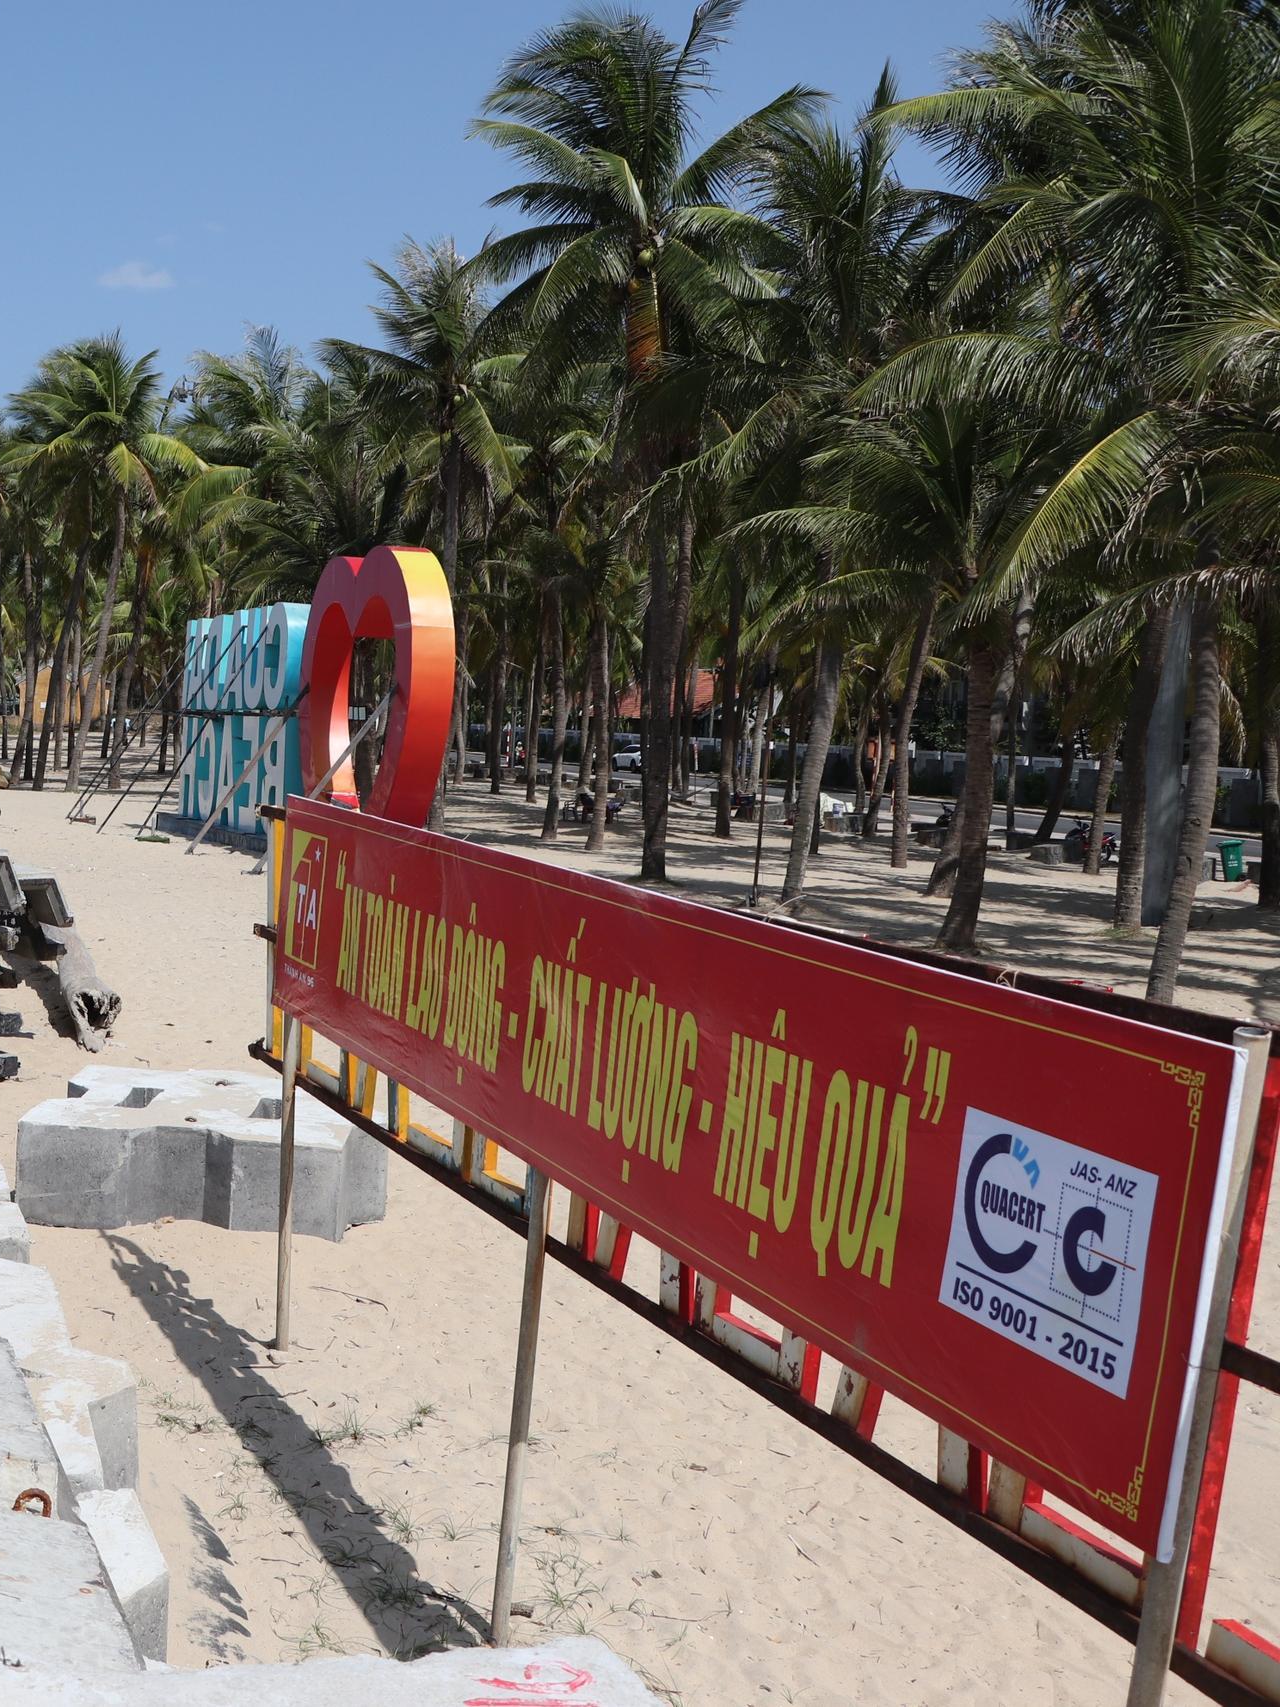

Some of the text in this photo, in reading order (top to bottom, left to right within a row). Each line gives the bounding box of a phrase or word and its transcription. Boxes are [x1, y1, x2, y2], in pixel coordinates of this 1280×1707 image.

[405, 909, 447, 1041] LAO
[442, 902, 506, 1086] ĐỘNG
[521, 917, 592, 1118] CHẤT
[587, 976, 698, 1184] LƯỢNG
[712, 1008, 814, 1260] HIỆU
[980, 1179, 1046, 1235] QUACERT
[952, 1276, 984, 1314] ISO
[988, 1296, 1038, 1343] 9001
[1058, 1331, 1117, 1382] 2015
